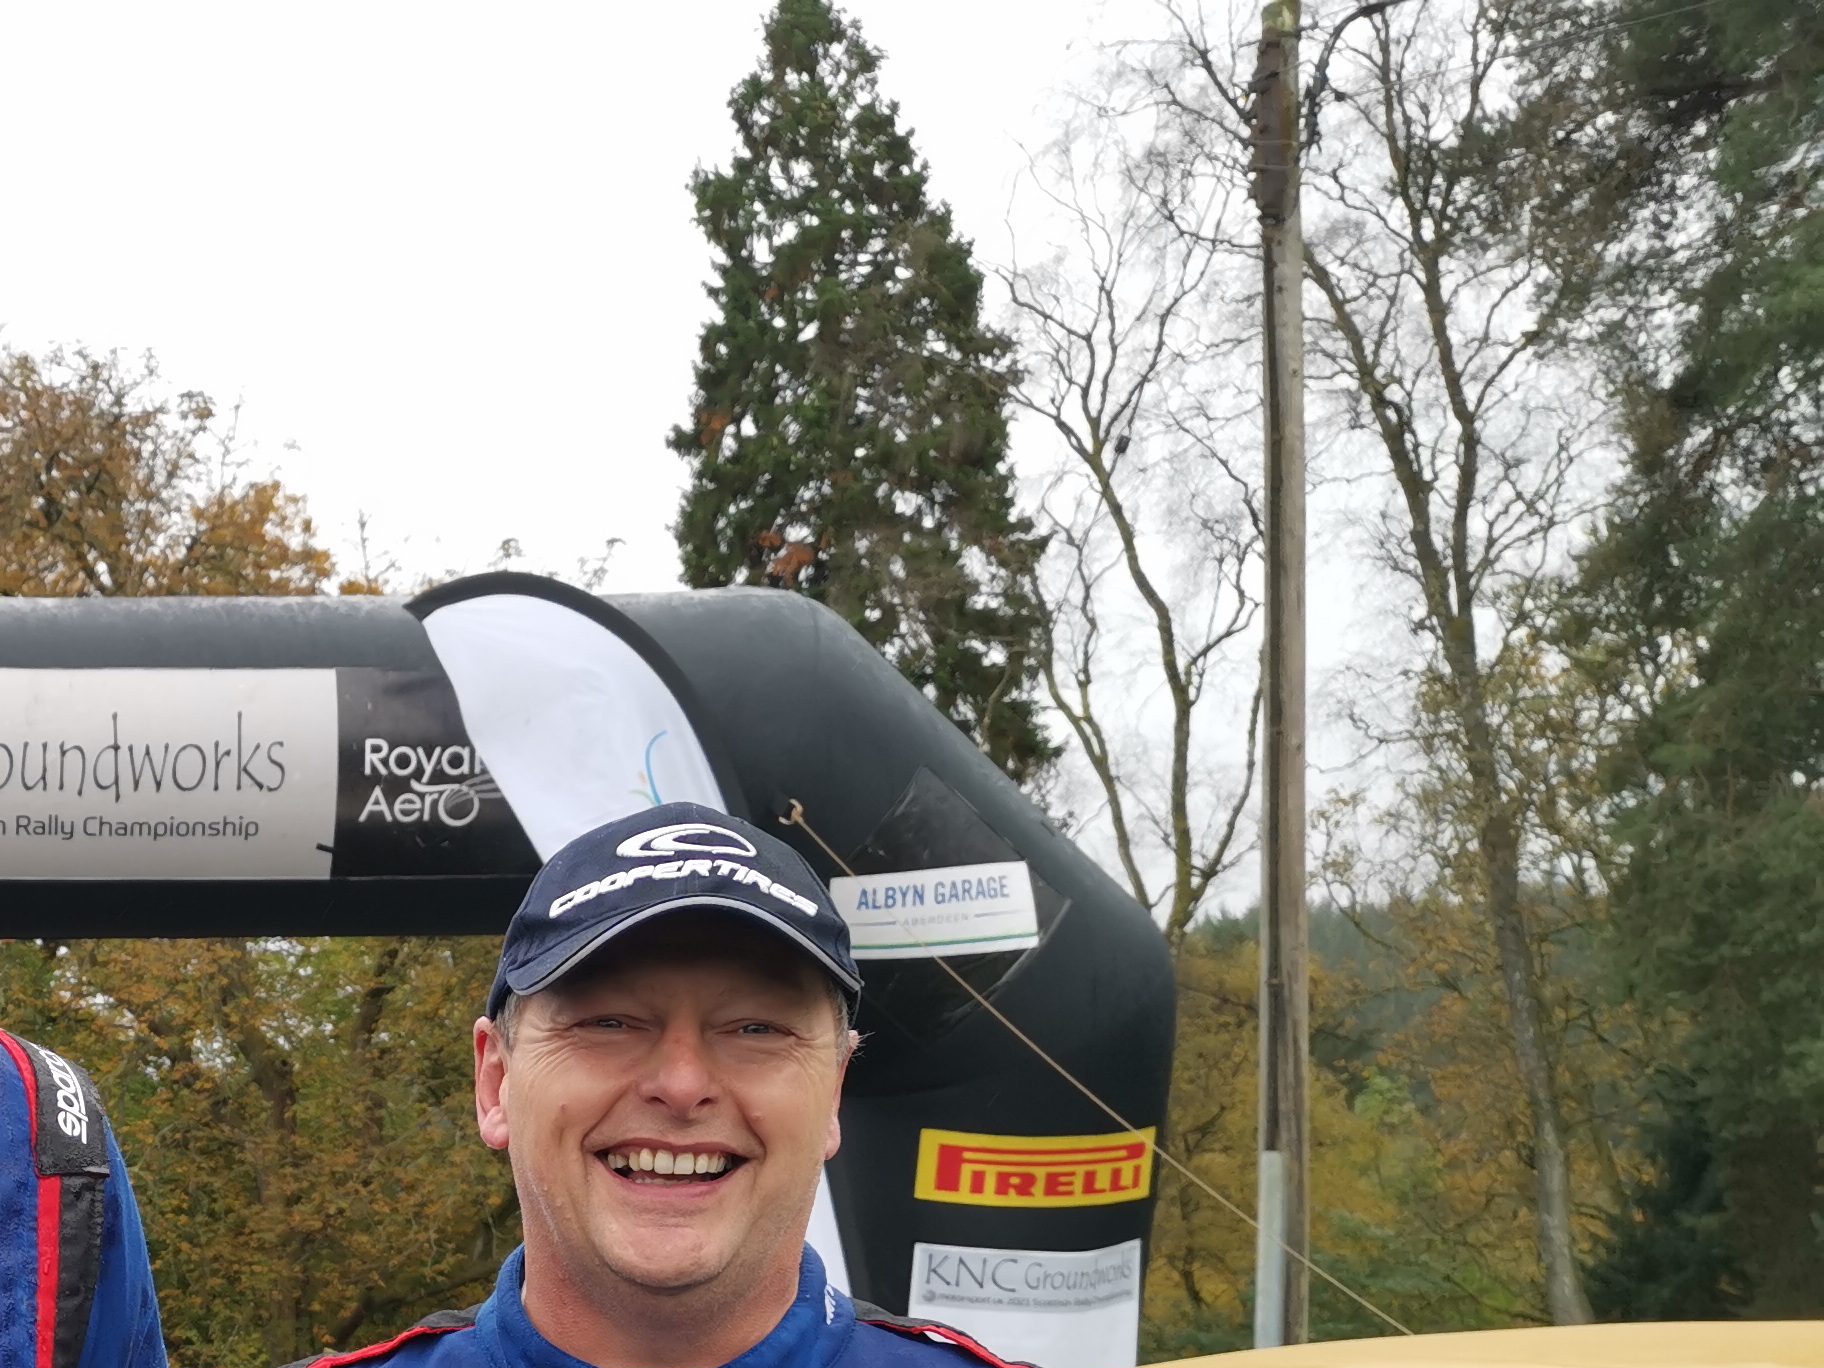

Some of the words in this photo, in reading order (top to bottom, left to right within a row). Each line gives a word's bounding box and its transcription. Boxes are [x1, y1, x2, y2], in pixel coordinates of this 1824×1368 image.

[15, 814, 75, 840] Rally
[82, 815, 259, 841] Championship
[856, 883, 925, 911] ALBYN
[934, 875, 1010, 905] GARAGE
[934, 1142, 1146, 1197] PIRELLI
[925, 1253, 1018, 1293] KNC
[1024, 1251, 1133, 1291] Groundworks
